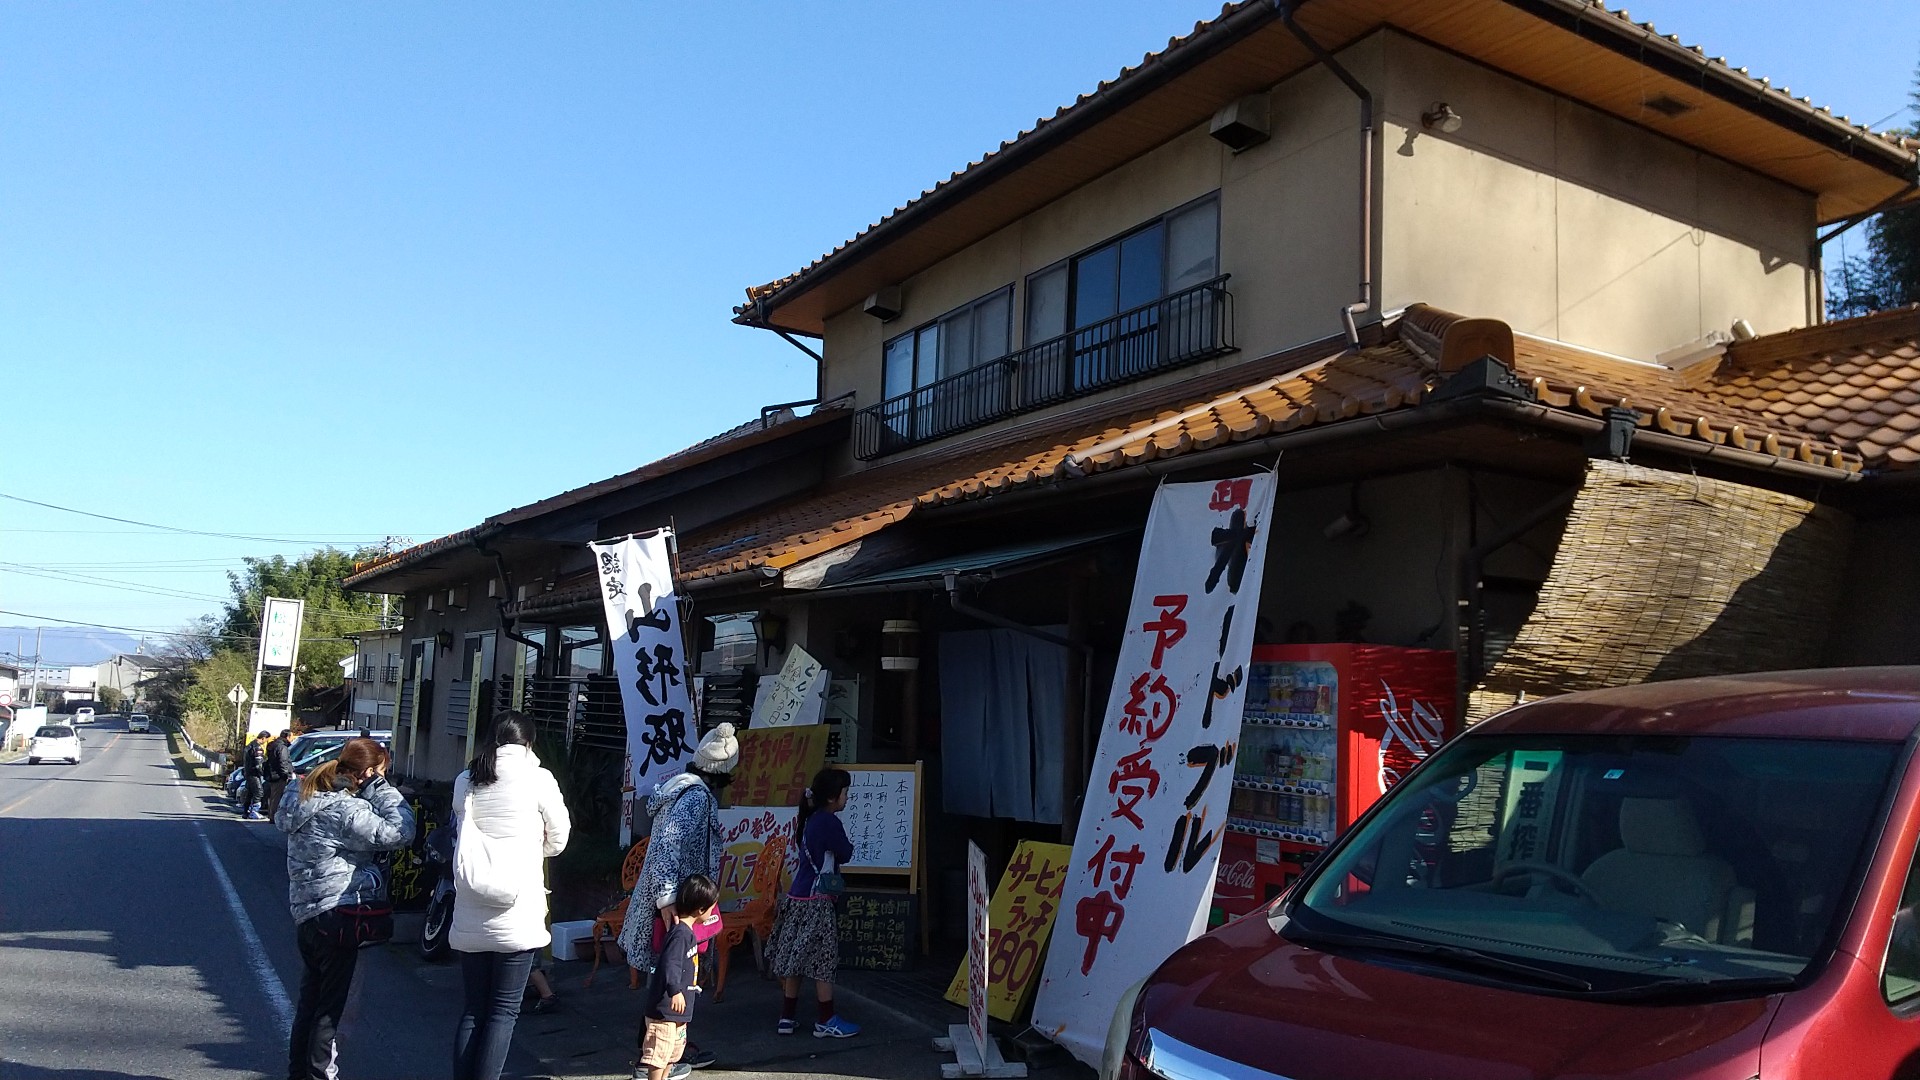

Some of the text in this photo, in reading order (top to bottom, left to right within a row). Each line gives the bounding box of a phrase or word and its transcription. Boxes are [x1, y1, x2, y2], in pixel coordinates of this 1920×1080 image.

[894, 778, 911, 867] 本日のおすすめ
[1076, 595, 1188, 976] 予約受付中
[1164, 509, 1258, 873] オードブル
